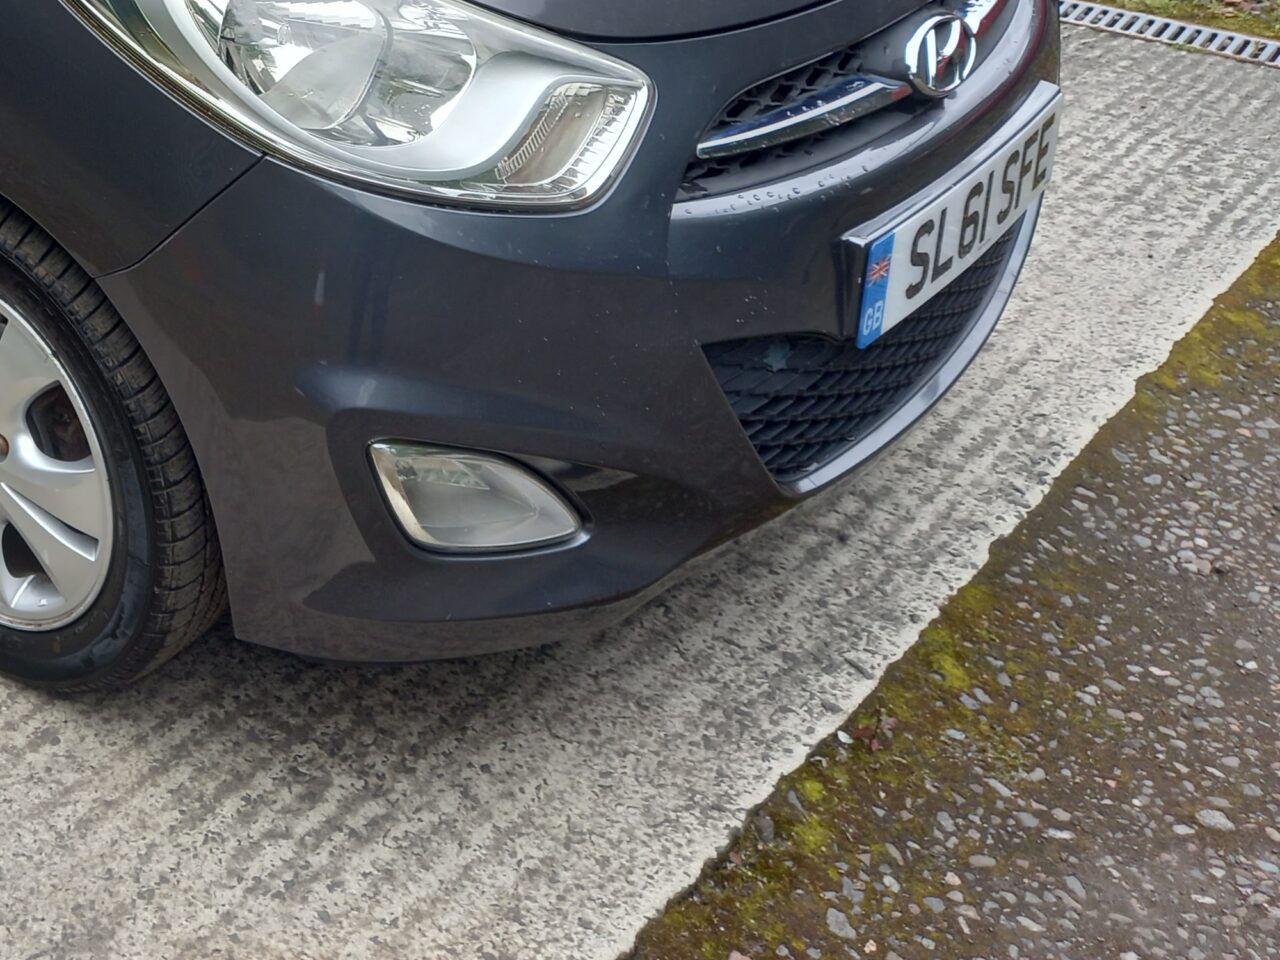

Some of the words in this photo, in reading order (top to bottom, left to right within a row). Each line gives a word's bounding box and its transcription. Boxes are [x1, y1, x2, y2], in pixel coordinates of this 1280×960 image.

[905, 170, 994, 300] SL61
[996, 112, 1056, 226] SFE
[862, 300, 885, 336] GB
